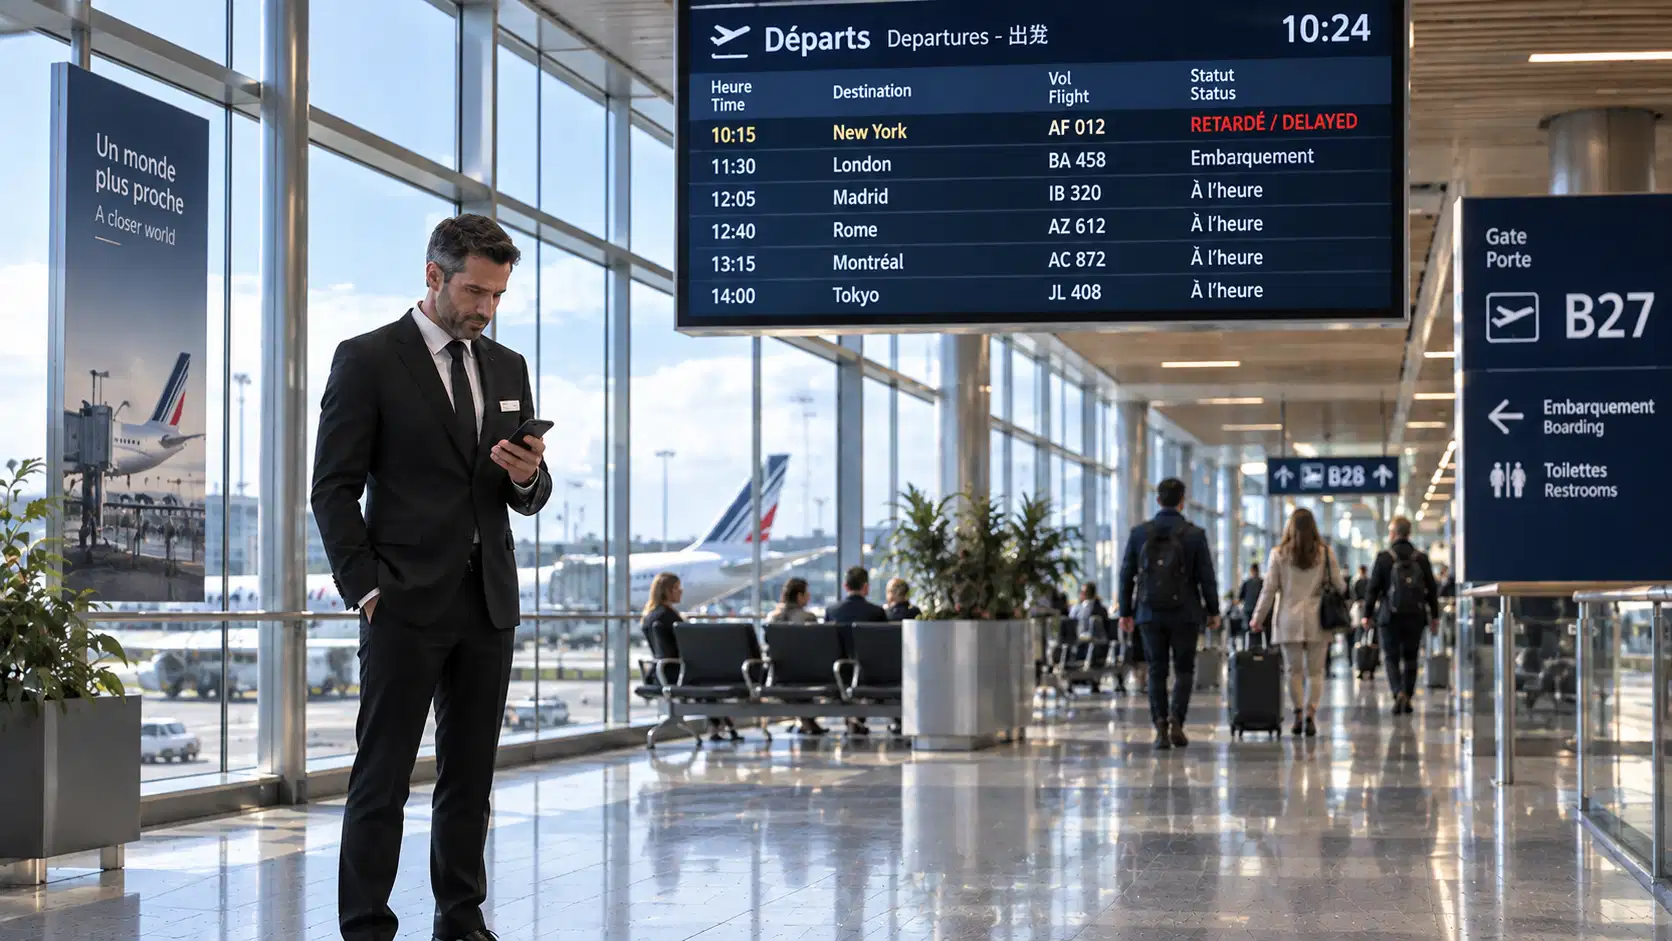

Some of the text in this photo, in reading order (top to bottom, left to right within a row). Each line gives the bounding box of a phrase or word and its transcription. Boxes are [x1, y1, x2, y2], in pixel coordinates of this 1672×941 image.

[1282, 13, 1371, 43] 10:24
[765, 25, 871, 58] Départs
[887, 28, 989, 51] Departures
[1048, 70, 1072, 86] Vol
[1190, 67, 1235, 83] Statut
[711, 79, 753, 94] Heure
[833, 82, 912, 100] Destination
[1190, 86, 1237, 101] Status
[710, 97, 746, 112] Time
[1048, 88, 1090, 107] Flight
[1048, 118, 1106, 136] AF 012
[1191, 110, 1266, 133] RETARDÉ
[1282, 112, 1358, 131] DELAYED
[711, 126, 756, 144] 10:15
[833, 122, 908, 141] New York
[96, 132, 177, 183] Un monde
[711, 157, 756, 175] 11:30
[833, 154, 892, 172] London
[1049, 151, 1106, 169] BA 458
[1191, 148, 1315, 169] Embarquement
[95, 167, 184, 215] plus proche
[833, 187, 889, 206] Madrid
[1049, 184, 1102, 202] IB 320
[1190, 178, 1264, 199] À l’heure
[711, 190, 756, 208] 12:05
[94, 204, 176, 246] A closer world
[833, 221, 878, 238] Rome
[1048, 217, 1106, 235] AZ 612
[1190, 211, 1264, 232] À l’heure
[711, 222, 756, 240] 12:40
[1485, 227, 1528, 246] Gate
[711, 255, 756, 273] 13:15
[833, 252, 904, 271] Montréal
[1048, 250, 1106, 268] AC 872
[1190, 245, 1264, 266] À l’heure
[1486, 250, 1532, 268] Porte
[711, 287, 756, 305] 14:00
[832, 285, 880, 307] Tokyo
[1048, 283, 1102, 301] JL 408
[1190, 278, 1264, 299] À l’heure
[1565, 291, 1656, 339] B27
[1543, 398, 1656, 418] Embarquement
[1543, 419, 1605, 438] Boarding
[1327, 465, 1366, 488] B28
[1543, 461, 1608, 479] Toilettes
[1544, 481, 1619, 499] Restrooms
